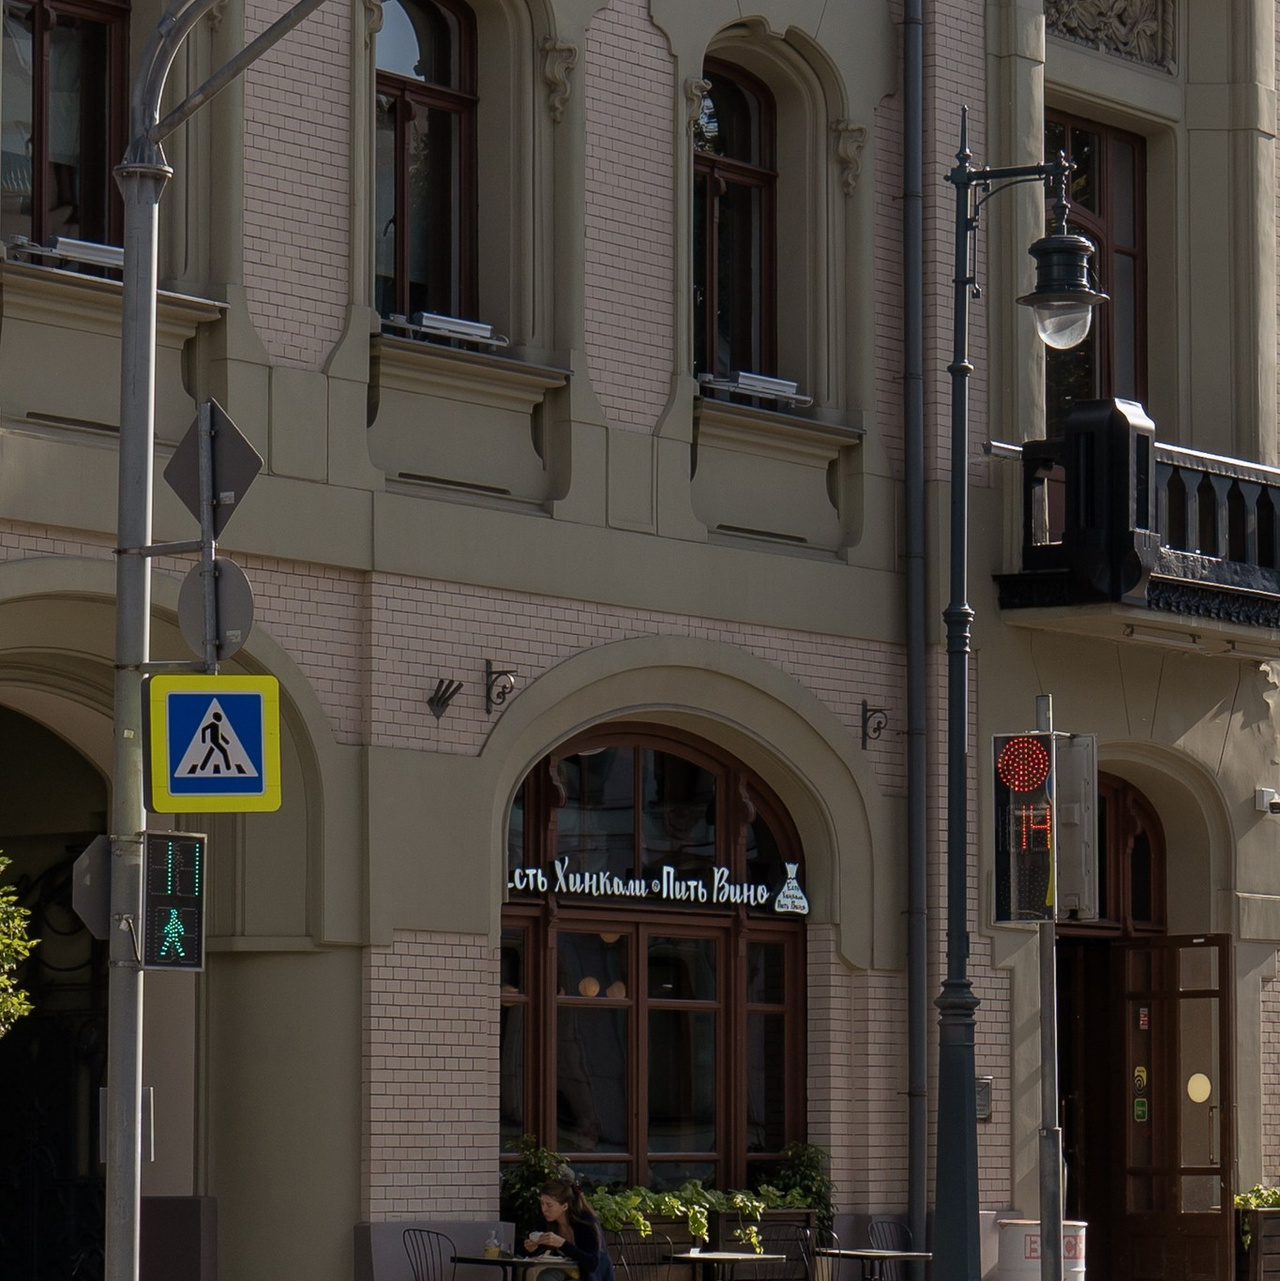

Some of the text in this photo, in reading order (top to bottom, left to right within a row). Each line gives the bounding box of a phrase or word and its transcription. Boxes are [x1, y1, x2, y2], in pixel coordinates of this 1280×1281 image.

[508, 856, 769, 906] сть Хинкали Пить Вино
